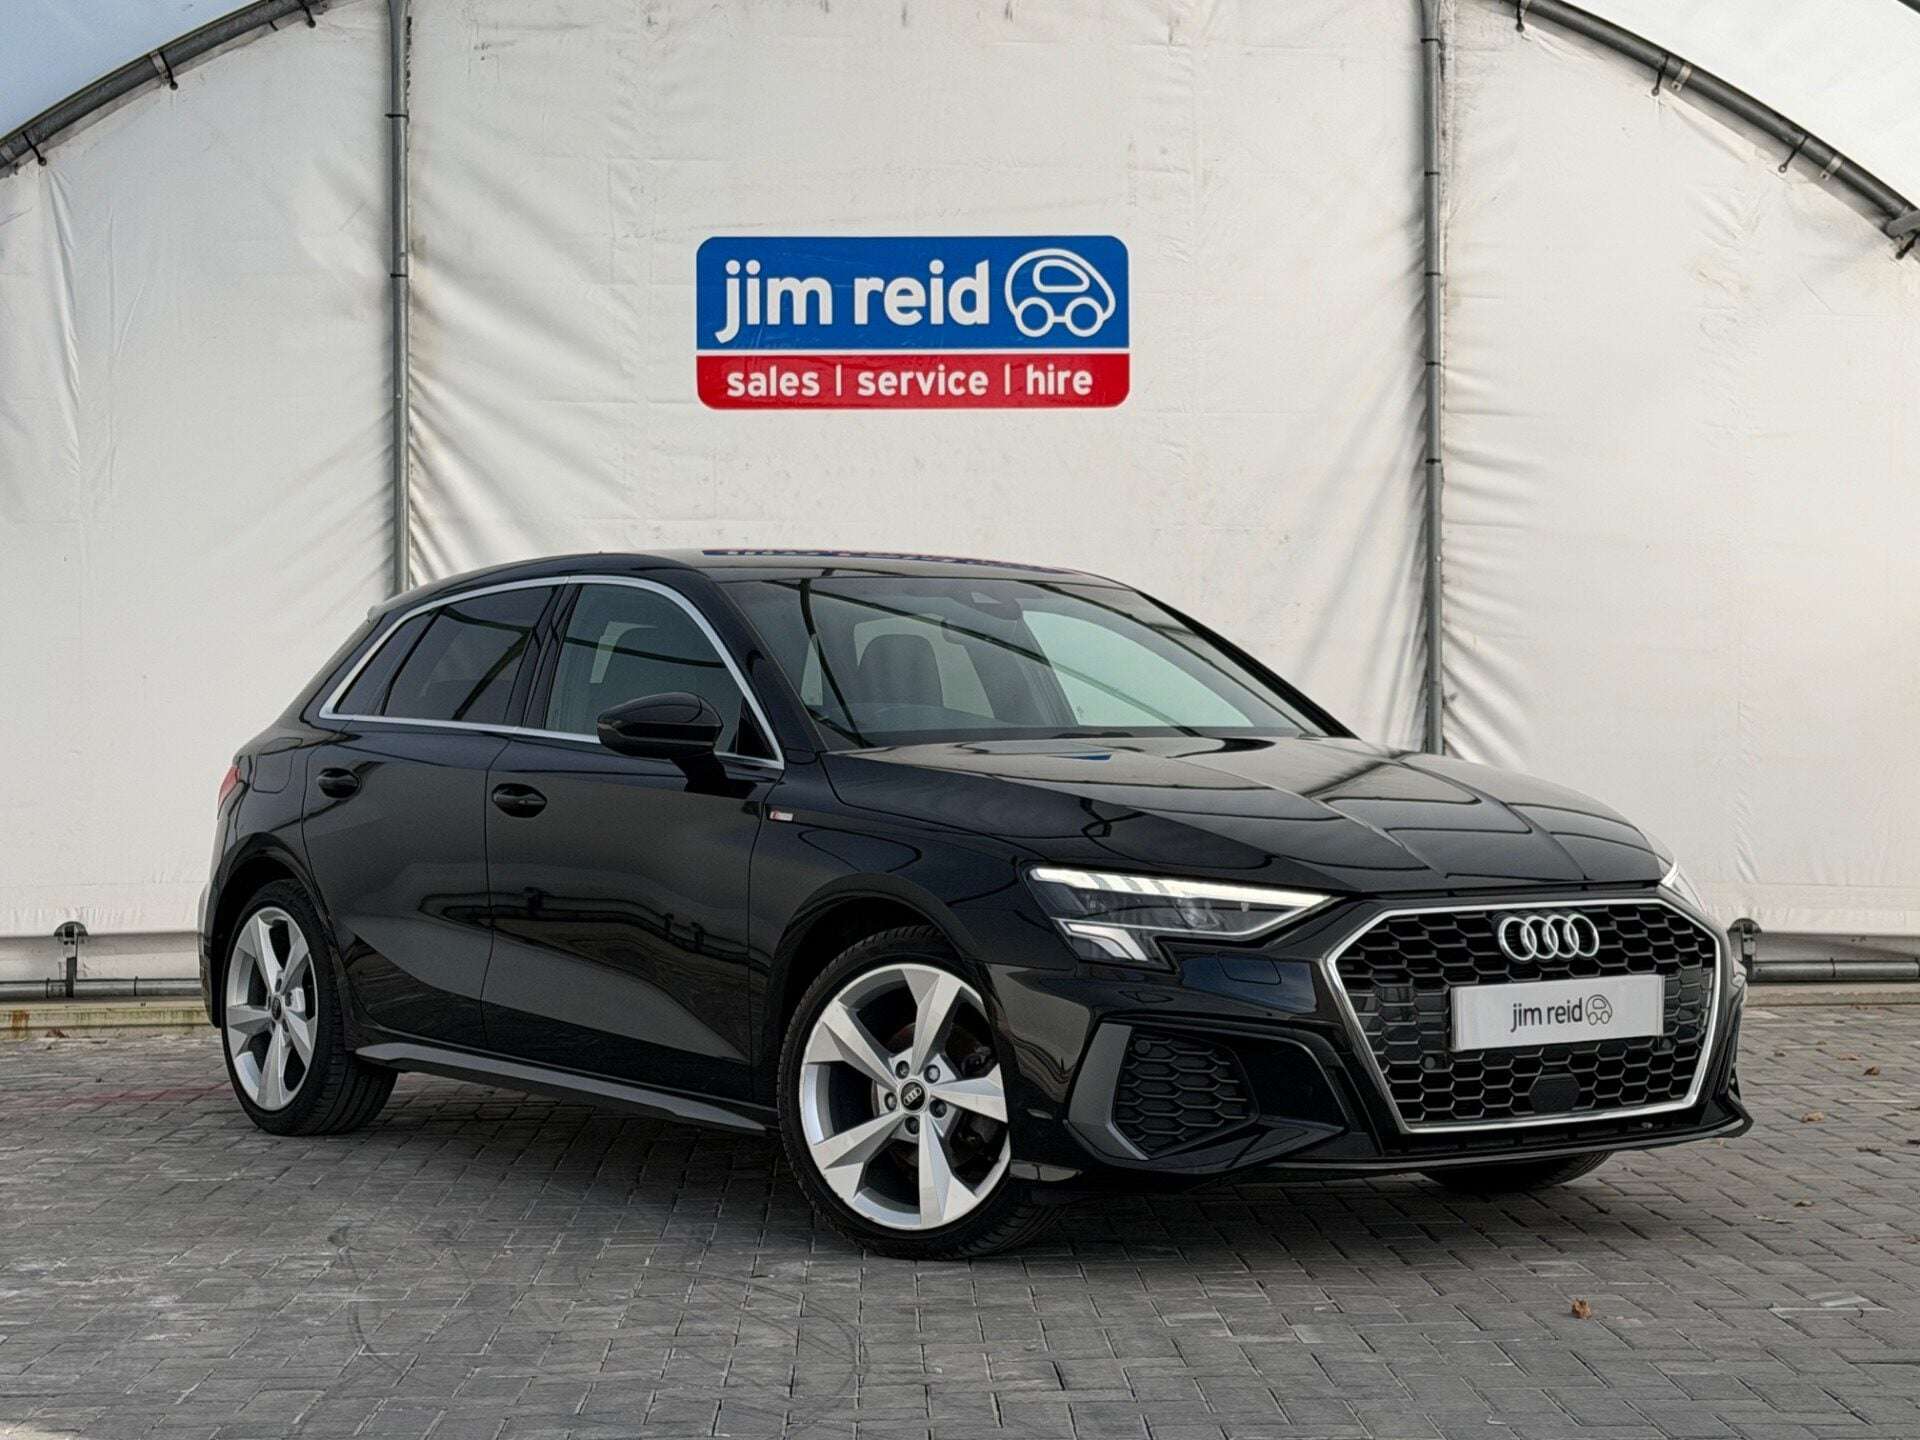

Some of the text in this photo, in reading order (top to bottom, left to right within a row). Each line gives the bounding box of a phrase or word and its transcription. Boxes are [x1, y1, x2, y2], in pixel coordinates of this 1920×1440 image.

[715, 259, 990, 343] jim reid
[727, 365, 820, 397] sales
[857, 364, 989, 397] service
[1026, 363, 1093, 396] hire
[1510, 997, 1583, 1033] jim reid
